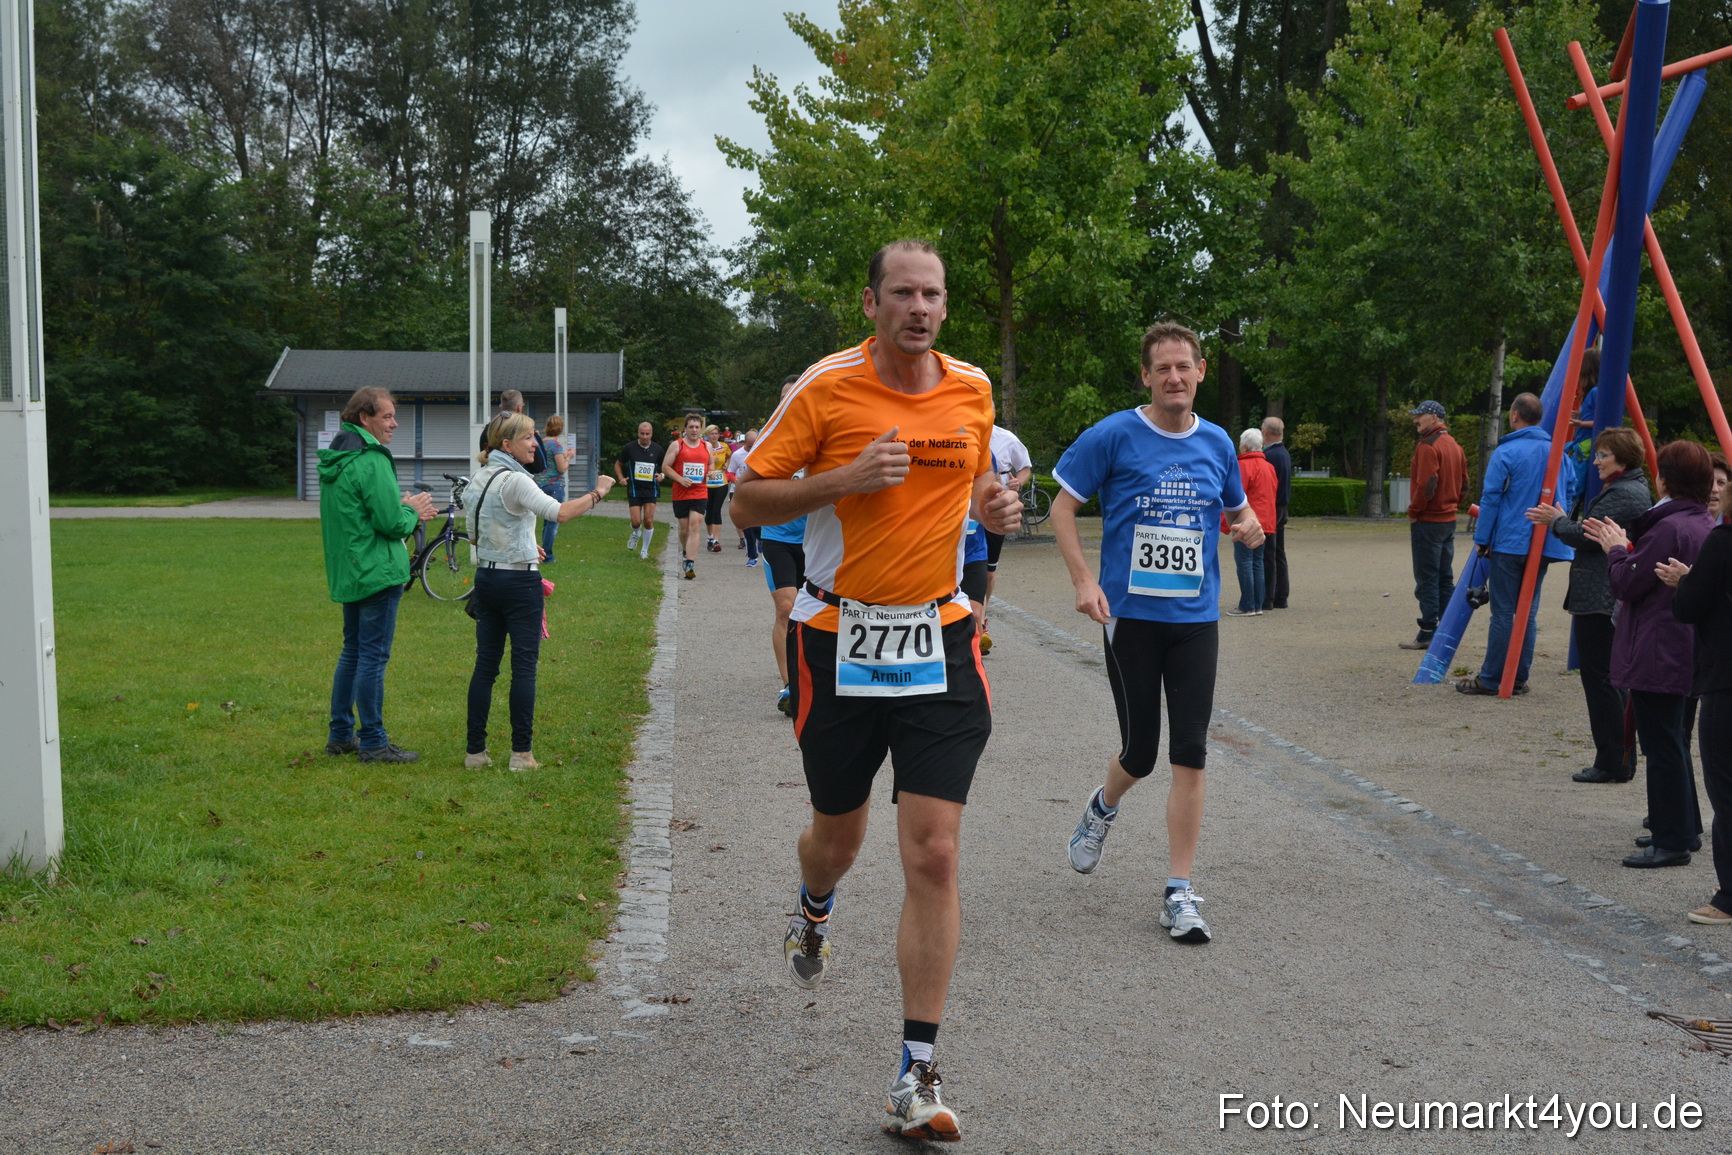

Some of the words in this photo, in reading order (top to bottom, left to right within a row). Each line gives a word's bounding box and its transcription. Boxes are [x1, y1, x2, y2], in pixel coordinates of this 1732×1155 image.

[909, 438, 926, 448] der
[928, 438, 968, 449] Notärzte
[910, 456, 947, 468] Feucht
[949, 459, 967, 470] e.V.
[685, 467, 703, 476] 2216
[1135, 531, 1160, 541] PARTL
[1161, 534, 1192, 544] Neumarkt
[1138, 542, 1197, 572] 3393
[842, 608, 874, 620] PARTL
[876, 610, 923, 620] Neumarkt
[848, 623, 934, 660] 2770
[870, 669, 912, 683] Armin
